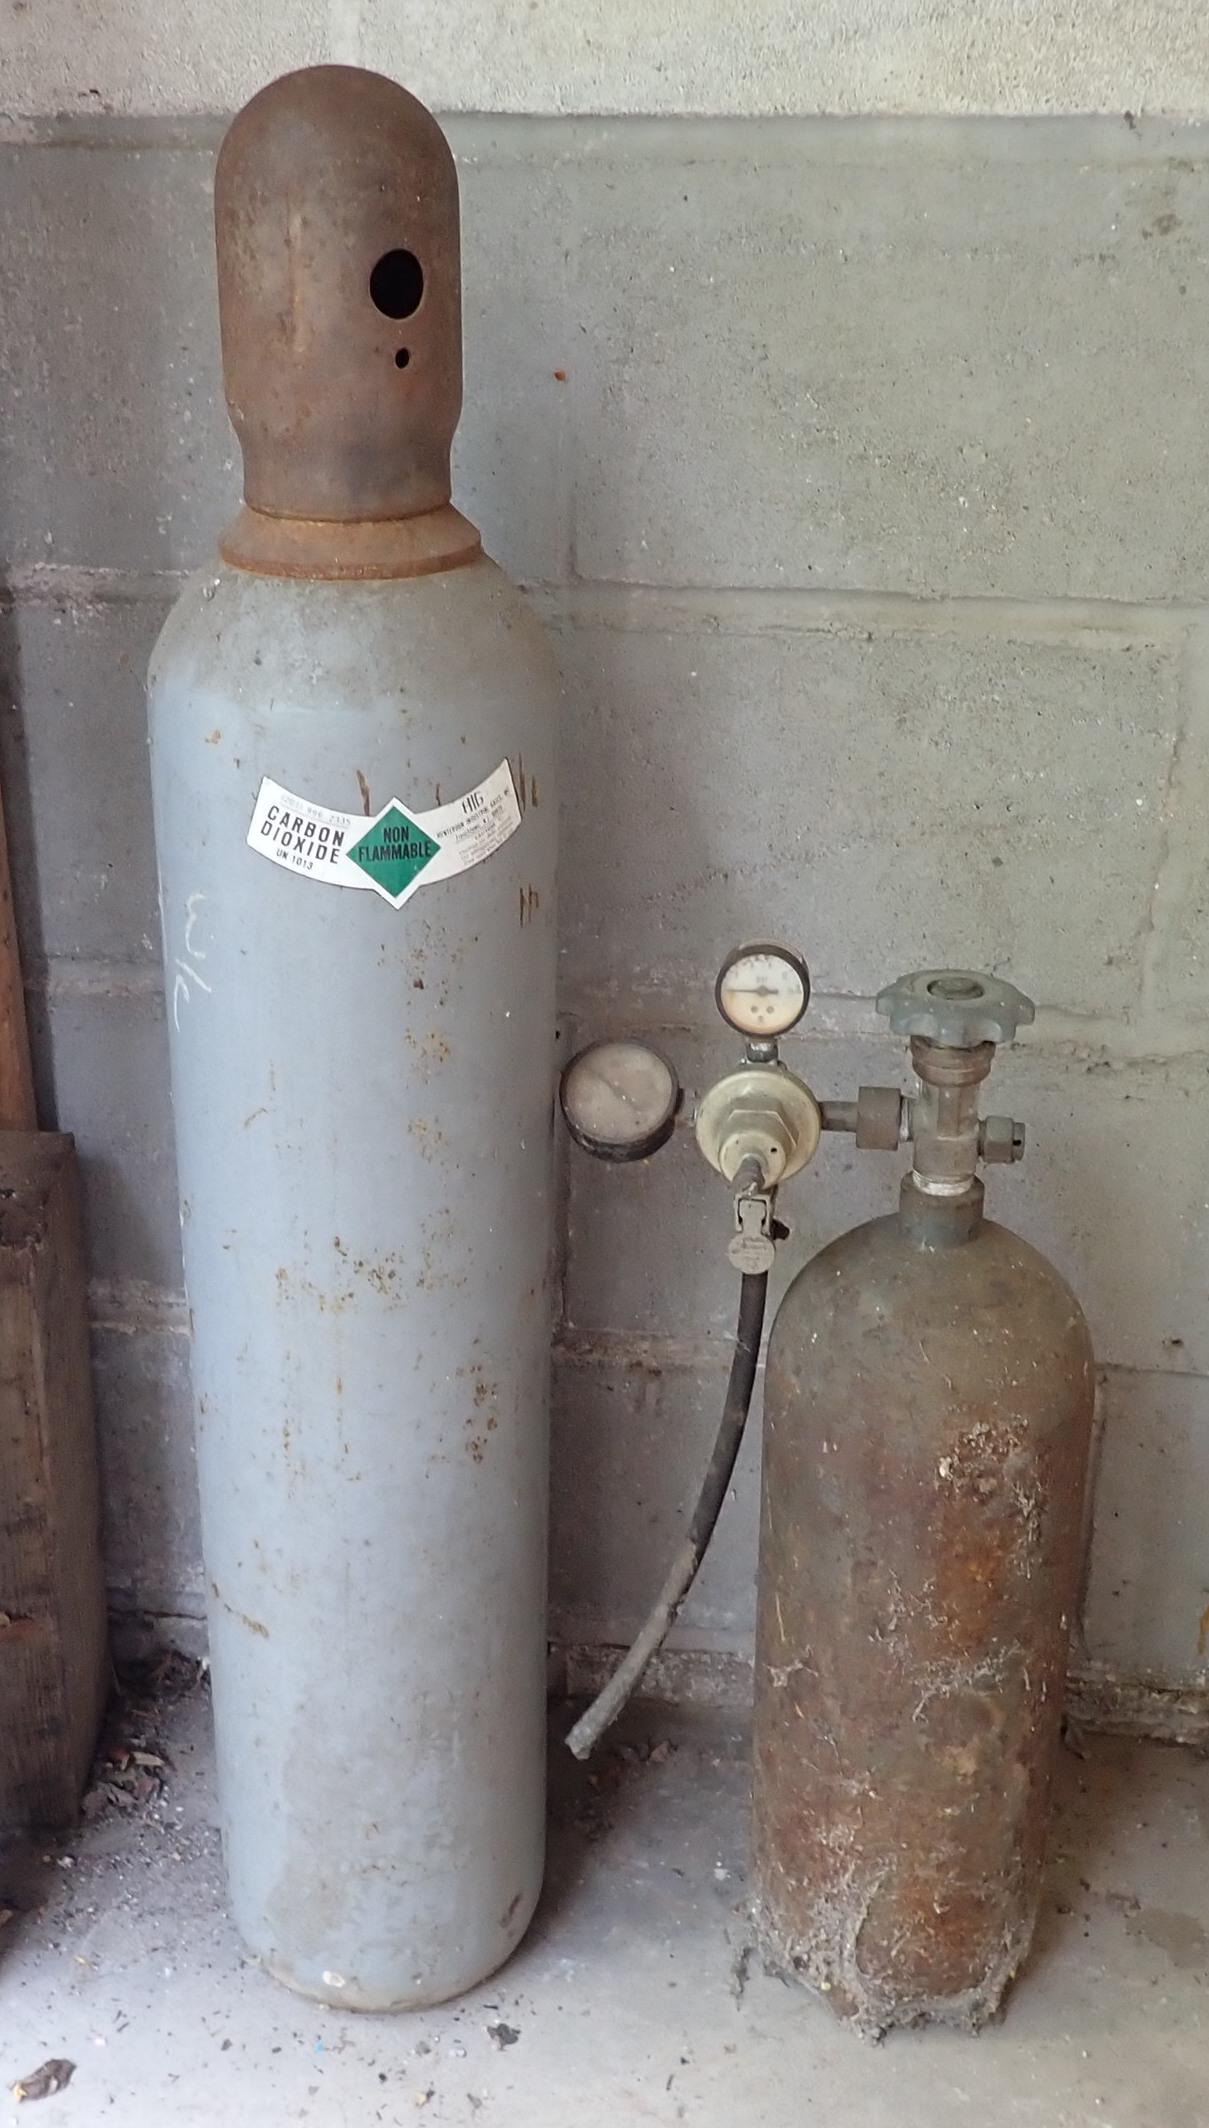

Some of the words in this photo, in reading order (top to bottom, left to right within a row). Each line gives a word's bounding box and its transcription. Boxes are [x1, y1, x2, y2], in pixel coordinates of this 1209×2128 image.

[267, 805, 345, 847] CARBON
[383, 825, 409, 843] NON
[260, 820, 340, 865] DIOXIDE
[358, 841, 432, 862] FLAMMABLE
[276, 848, 288, 860] UN
[292, 855, 313, 870] 1013
